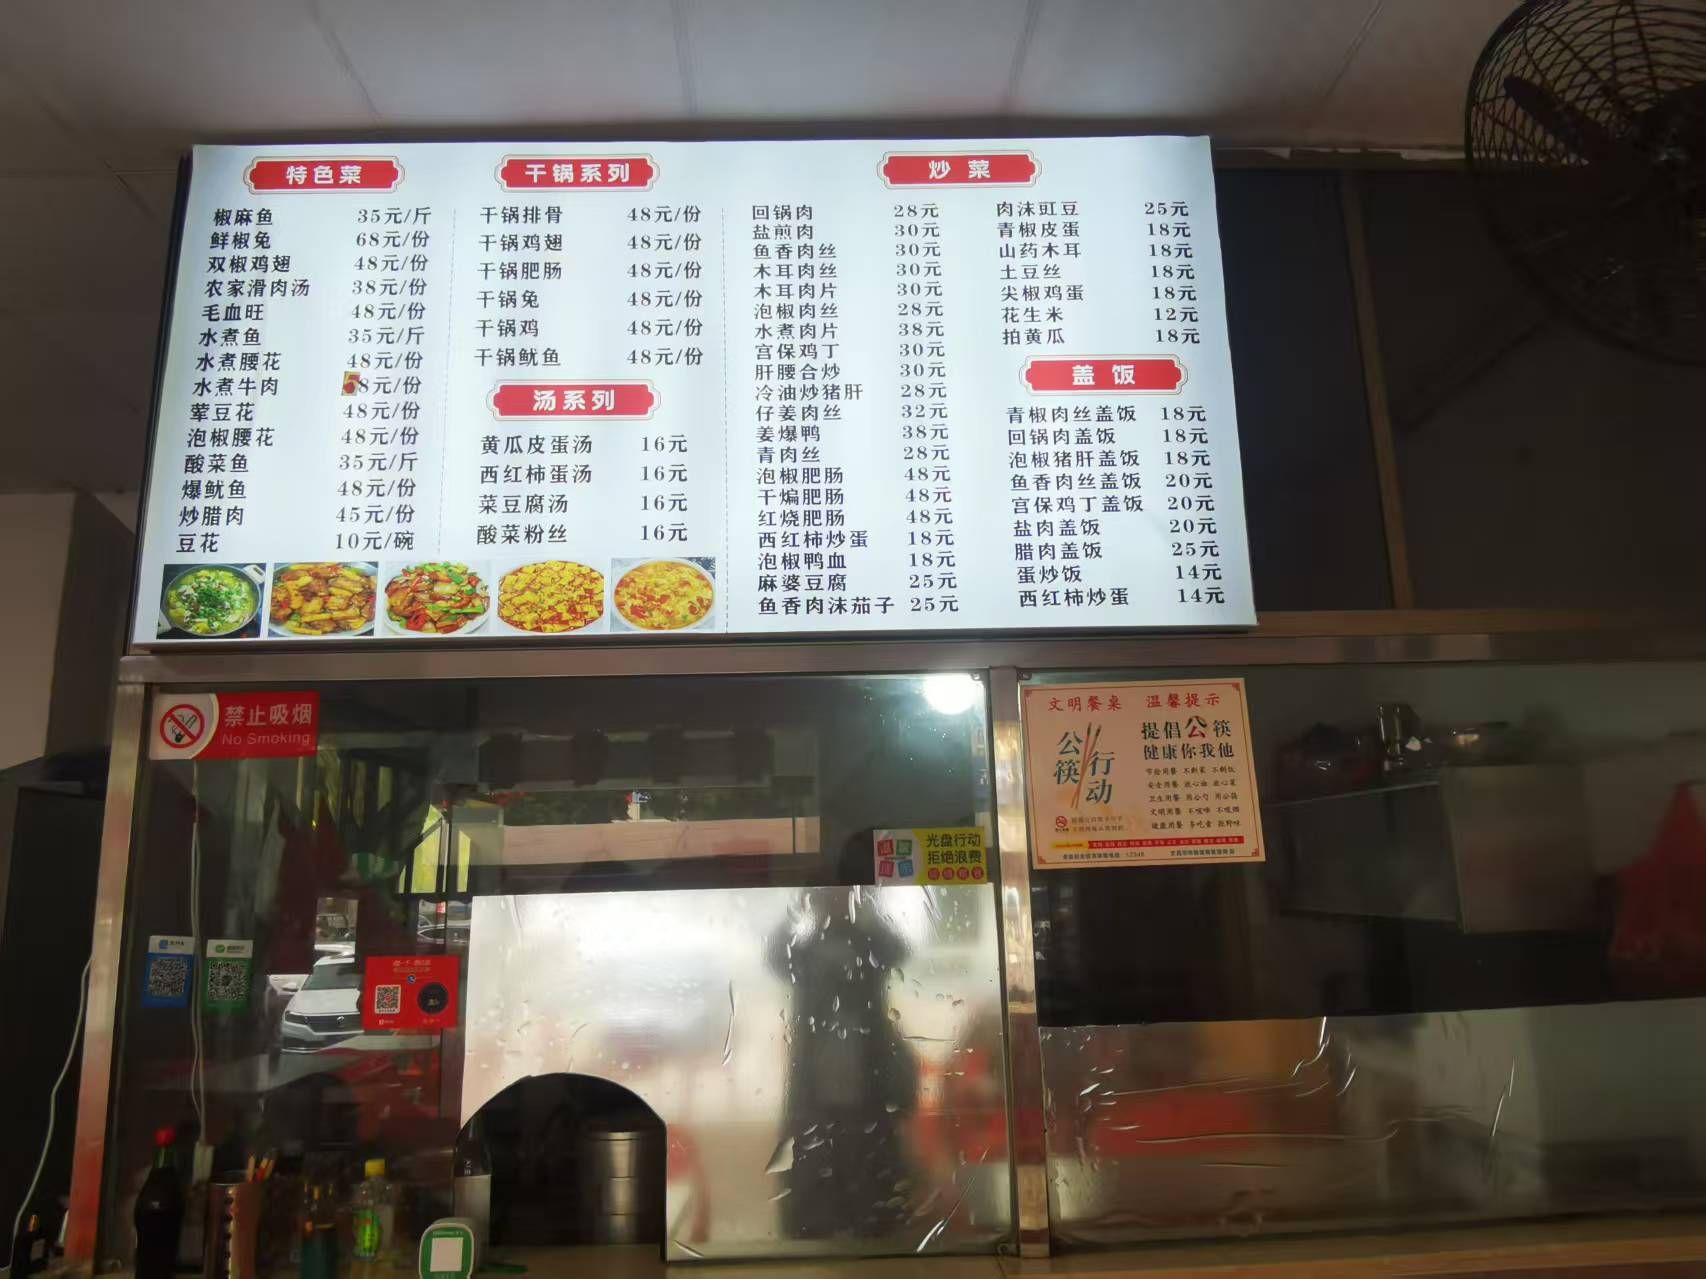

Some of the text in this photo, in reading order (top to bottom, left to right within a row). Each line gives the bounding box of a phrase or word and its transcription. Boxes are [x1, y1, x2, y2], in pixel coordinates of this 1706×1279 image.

[286, 165, 363, 185] 特色菜
[525, 163, 630, 183] 干锅系列
[928, 159, 992, 180] 炒菜
[213, 207, 431, 226] 椒麻鱼 35元/斤
[480, 205, 701, 224] 干锅排骨 48元/份
[752, 204, 939, 220] 回锅肉 28元
[1145, 201, 1189, 216] 25元
[753, 223, 940, 240] 盐煎肉 30元
[997, 221, 1191, 238] 青椒皮蛋 18元
[210, 231, 429, 249] 鲜椒兔 68元/份
[479, 233, 701, 252] 干锅鸡翅 48元/份
[754, 243, 940, 259] 鱼香肉丝 30元
[1000, 242, 1193, 258] 山药木耳 18元
[207, 254, 428, 273] 双椒鸡翅 48元/份
[477, 261, 702, 280] 干锅肥肠 48元/份
[753, 263, 942, 279] 木耳肉丝 30元
[1000, 264, 1195, 279] 土豆丝 18元
[205, 278, 427, 298] 农家滑肉汤 38元/份
[754, 282, 942, 299] 木耳肉片 30元
[1001, 285, 1197, 301] 尖椒鸡蛋 18元
[477, 290, 703, 308] 干锅兔 48元/份
[202, 302, 426, 321] 毛血旺 48元/份
[754, 303, 943, 319] 泡椒肉丝 28元
[1001, 306, 1198, 323] 花生米 12元
[198, 326, 424, 347] 水煮鱼 35元/斤
[476, 318, 703, 337] 干锅鸡 48元/份
[755, 321, 944, 339] 水煮肉片 38元
[1002, 328, 1200, 345] 拍黄瓜 18元
[195, 351, 423, 371] 水煮腰花 48元/份
[474, 347, 703, 366] 干锅鱿鱼 48元/份
[755, 343, 945, 360] 宫保鸡丁 30元
[755, 363, 946, 380] 肝腰合炒 30元
[1072, 364, 1136, 386] 盖饭
[192, 377, 278, 396] 水煮牛肉
[756, 383, 947, 401] 冷油炒猪肝 28元
[533, 389, 615, 412] 汤系列
[190, 401, 420, 422] 荤豆花 48元/份
[756, 404, 948, 422] 仔姜肉丝 32元
[1006, 405, 1206, 424] 青椒肉丝盖饭 18元
[187, 427, 419, 448] 泡椒腰花 48元/份
[756, 424, 948, 443] 姜爆鸭 38元
[1008, 428, 1208, 446] 回锅肉盖饭 18元
[481, 435, 687, 455] 黄瓜皮蛋汤 16元
[757, 444, 949, 464] 青肉丝 28元
[184, 452, 418, 474] 酸菜鱼 35元/斤
[1009, 450, 1211, 468] 泡椒猪肝盖饭 18元
[480, 464, 687, 484] 西红柿蛋汤 16元
[757, 467, 950, 484] 泡椒肥肠 48元
[1011, 472, 1212, 491] 鱼香肉丝盖饭 20元
[182, 478, 416, 500] 爆鱿鱼 48元/份
[758, 488, 952, 506] 干煸肥肠 48元
[479, 493, 687, 514] 菜豆腐汤 16元
[1012, 495, 1215, 514] 宫保鸡丁盖饭 20元
[179, 504, 415, 527] 炒腊肉 45元/份
[758, 509, 953, 527] 红烧肥肠 48元
[477, 524, 688, 544] 酸菜粉丝 16元
[1014, 518, 1217, 537] 盐肉盖饭 20元
[176, 530, 414, 553] 豆花 10元/碗
[758, 529, 954, 549] 西红柿炒蛋 18元
[1015, 542, 1219, 560] 腊肉盖饭 25元
[758, 552, 955, 570] 泡椒鸭血 18元
[758, 573, 957, 592] 麻婆豆腐 25元
[1017, 563, 1222, 584] 蛋炒饭 14元
[911, 598, 959, 612] 25元
[1018, 587, 1225, 607] 西红柿炒蛋 14元
[1048, 693, 1221, 712] 文明餐桌 温馨提示
[224, 703, 312, 728] 禁止吸烟
[1141, 715, 1232, 740] 提倡公筷
[222, 730, 311, 746] No Smoking
[1054, 731, 1083, 784] 公筷
[1144, 743, 1235, 760] 健康你我他
[1086, 751, 1115, 804] 行动
[926, 832, 981, 848] 光盘行动
[927, 850, 982, 864] 拒绝浪费
